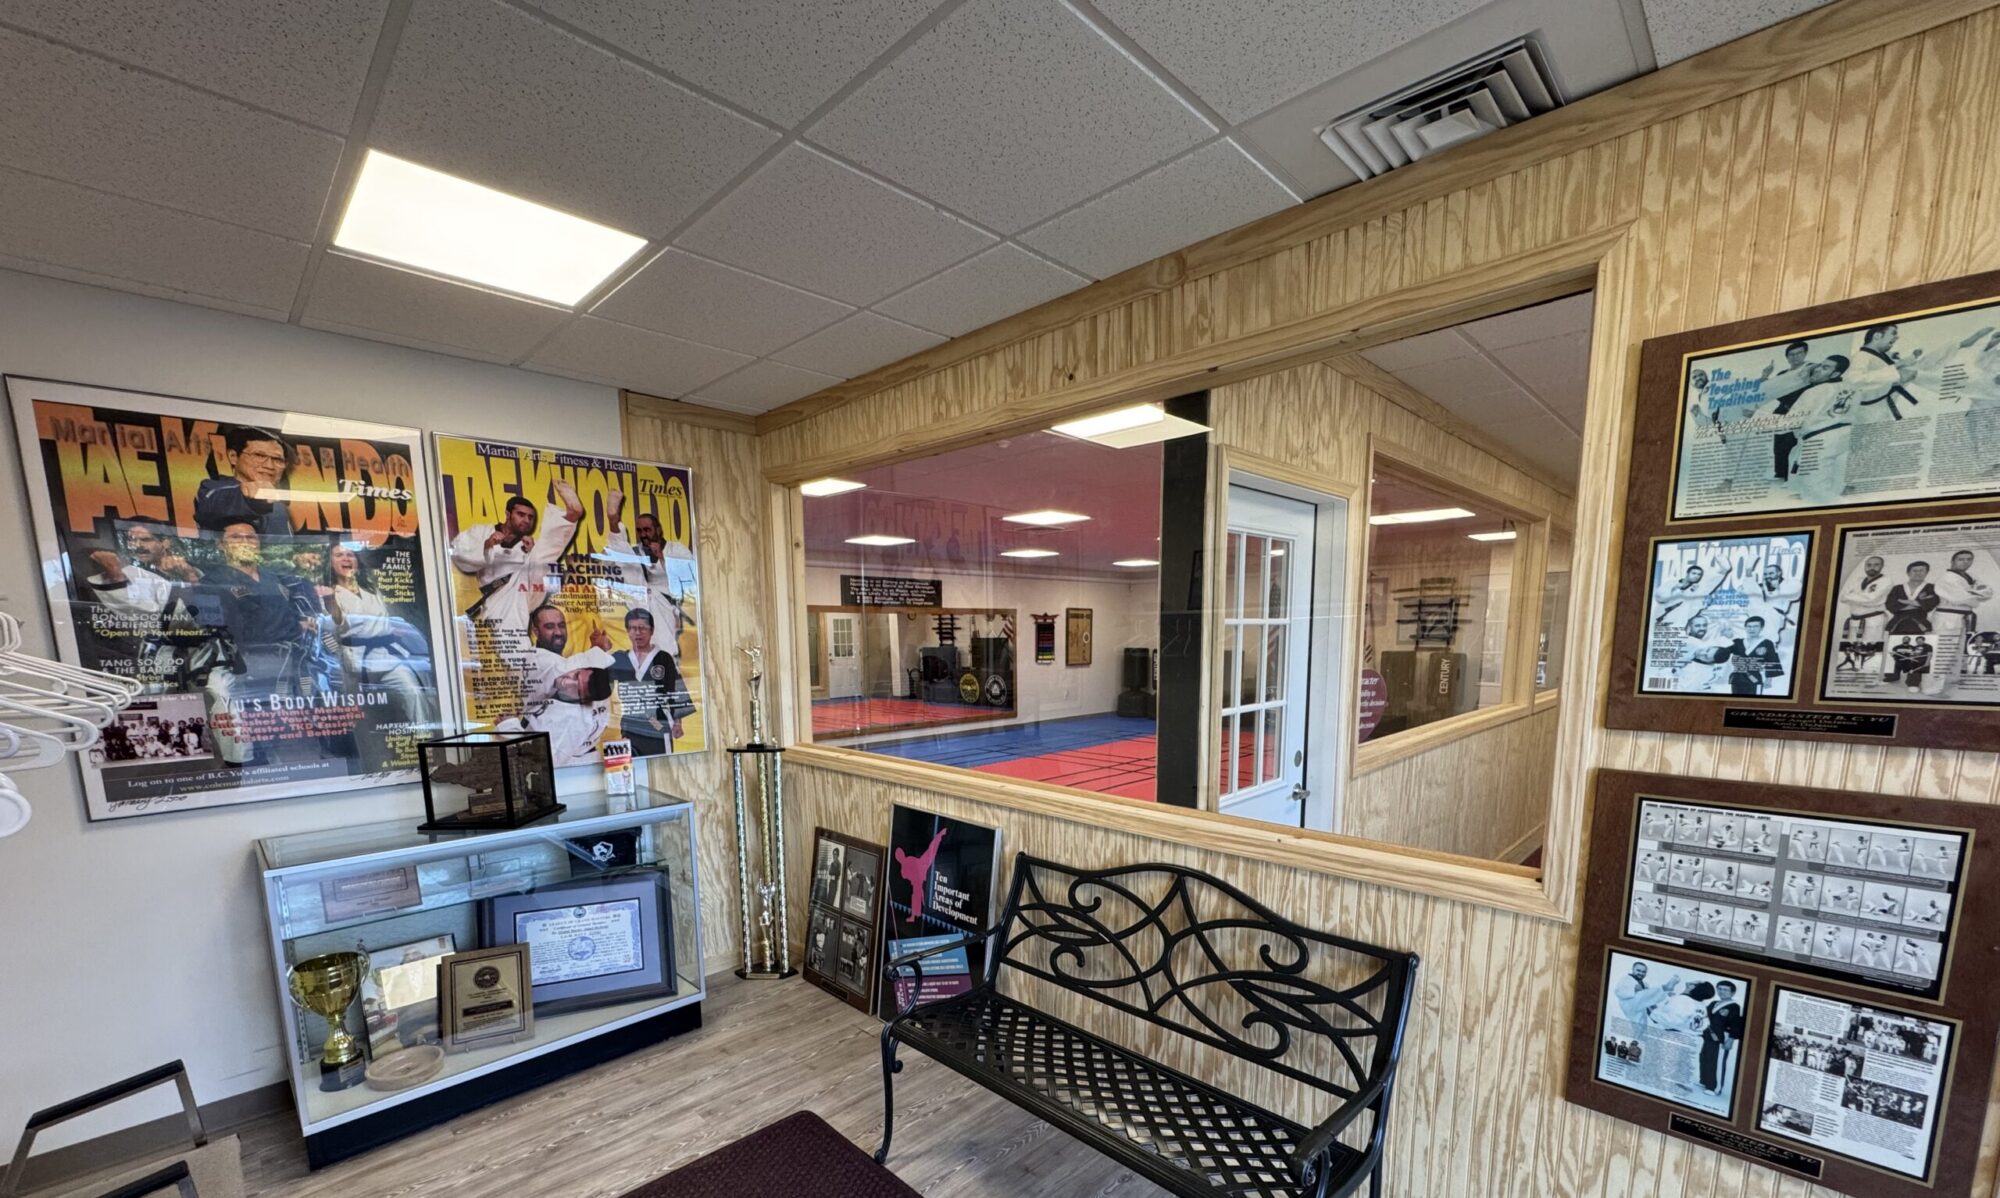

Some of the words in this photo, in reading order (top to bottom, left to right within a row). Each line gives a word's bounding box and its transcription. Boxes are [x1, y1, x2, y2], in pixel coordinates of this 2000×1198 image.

[1712, 368, 1731, 380] The
[1709, 378, 1761, 395] Teaching
[1708, 392, 1766, 409] Tradition:
[49, 416, 157, 451] Marial
[477, 443, 519, 458] Martial
[551, 453, 590, 467] Fitness
[591, 457, 601, 467] &
[604, 460, 637, 473] Health
[339, 478, 412, 500] Times
[640, 478, 683, 496] Times
[389, 570, 413, 578] Family
[548, 563, 622, 576] TEACHING
[518, 584, 528, 592] A
[91, 613, 132, 621] BONG
[163, 613, 189, 621] HAN
[93, 621, 163, 629] EXPERIENCE
[132, 629, 147, 638] Up
[150, 628, 173, 636] Your
[100, 659, 132, 667] TANG
[137, 658, 167, 666] SOO
[168, 657, 185, 666] DO
[115, 666, 135, 674] THE
[140, 665, 179, 674] BADGE
[1439, 658, 1450, 695] CENTURY
[270, 694, 315, 711] BODY
[321, 691, 388, 708] WISDOM
[314, 705, 359, 715] Method
[1730, 711, 1832, 721] GRANDMASTER
[280, 715, 310, 725] Your
[312, 712, 366, 722] Potential
[290, 723, 313, 732] TKD
[234, 734, 274, 743] Faster
[279, 732, 304, 740] and
[307, 729, 348, 738] Better!
[128, 779, 148, 789] Log
[150, 777, 162, 785] on
[164, 776, 174, 784] to
[176, 775, 195, 783] one
[196, 773, 207, 781] of
[208, 771, 227, 780] B.C.
[229, 769, 250, 778] Yu's
[252, 766, 288, 776] affiliated
[290, 763, 320, 771] schools
[935, 870, 948, 883] Ten
[934, 880, 970, 902] Important
[933, 891, 953, 906] Areas
[954, 899, 963, 909] of
[932, 900, 978, 925] Development
[1675, 1117, 1766, 1148] GRANDMASTER
